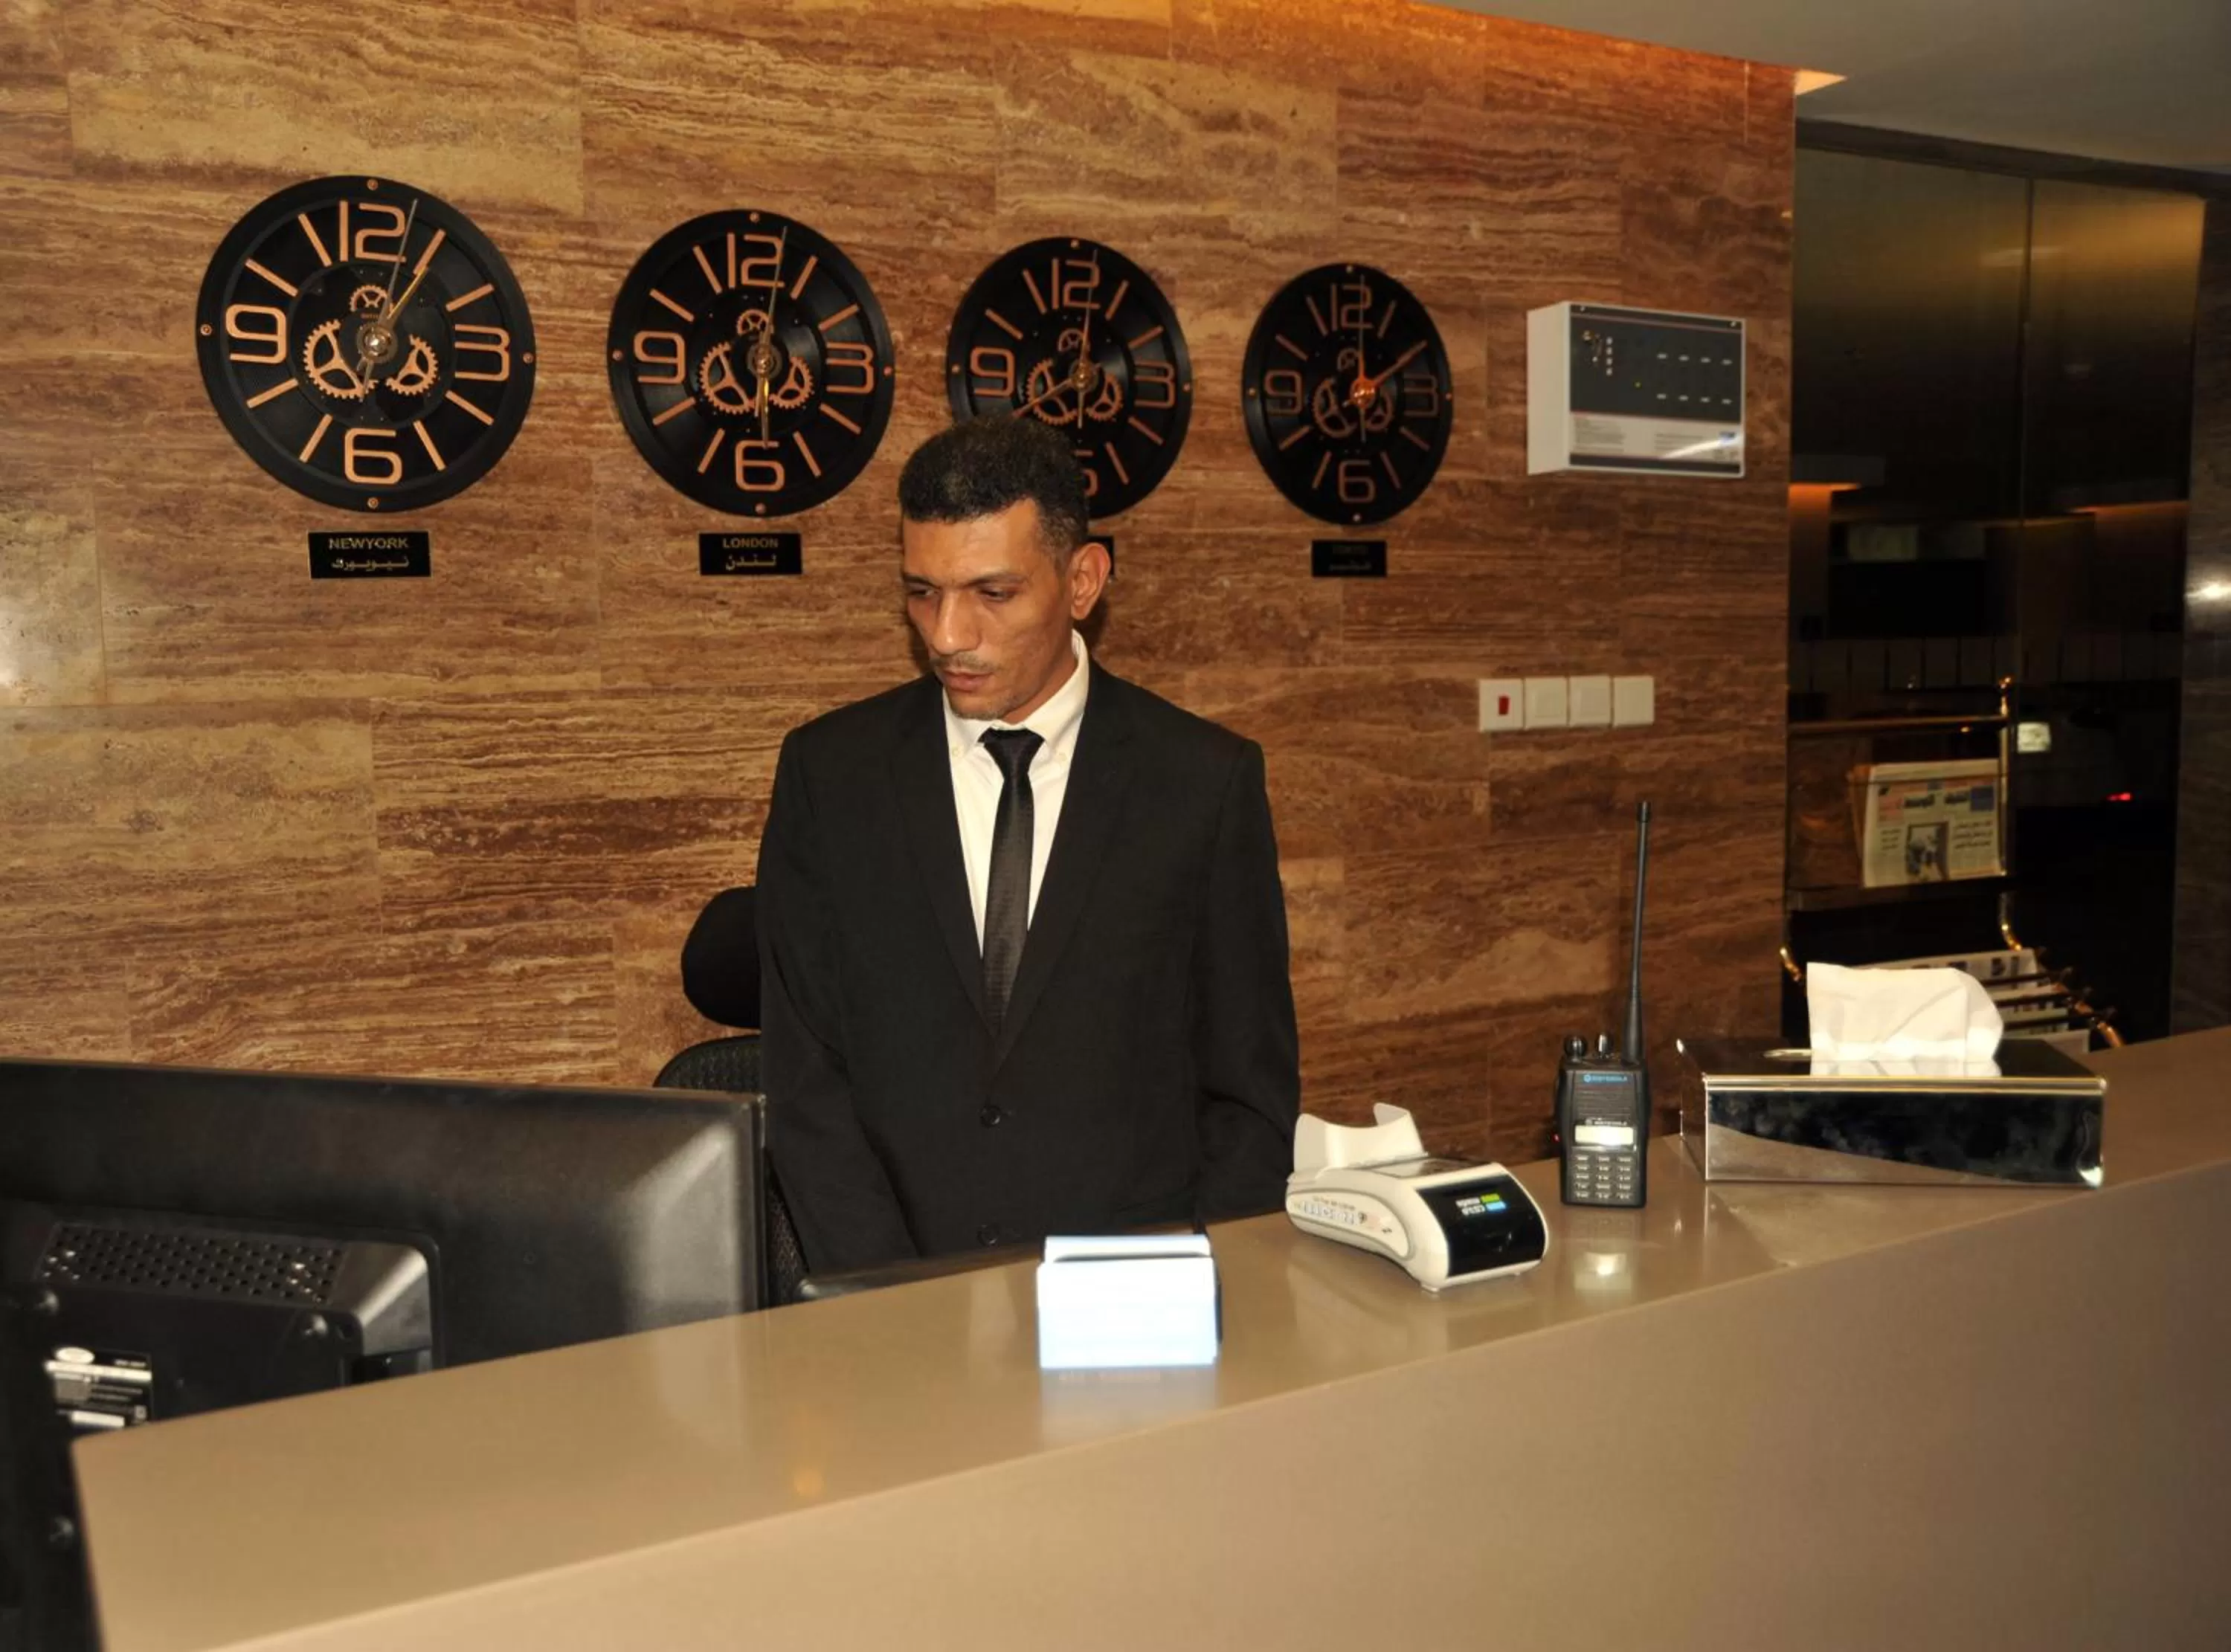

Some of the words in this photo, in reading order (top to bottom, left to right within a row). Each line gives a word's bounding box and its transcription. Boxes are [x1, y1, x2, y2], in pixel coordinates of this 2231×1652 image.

[339, 200, 407, 263] 12
[727, 233, 785, 288] 12
[1051, 257, 1101, 310] 12
[225, 303, 288, 364] 9
[1330, 283, 1374, 331] 12
[454, 323, 510, 381] 3
[633, 330, 686, 384] 9
[826, 341, 875, 394] 3
[970, 346, 1015, 398] 9
[1134, 359, 1176, 408] 3
[1265, 370, 1301, 416] 9
[1403, 373, 1439, 417] 3
[344, 427, 403, 485] 6
[735, 439, 786, 492] 6
[1339, 459, 1376, 503] 6
[328, 538, 408, 550] NEWYORK
[722, 538, 779, 549] LONDON
